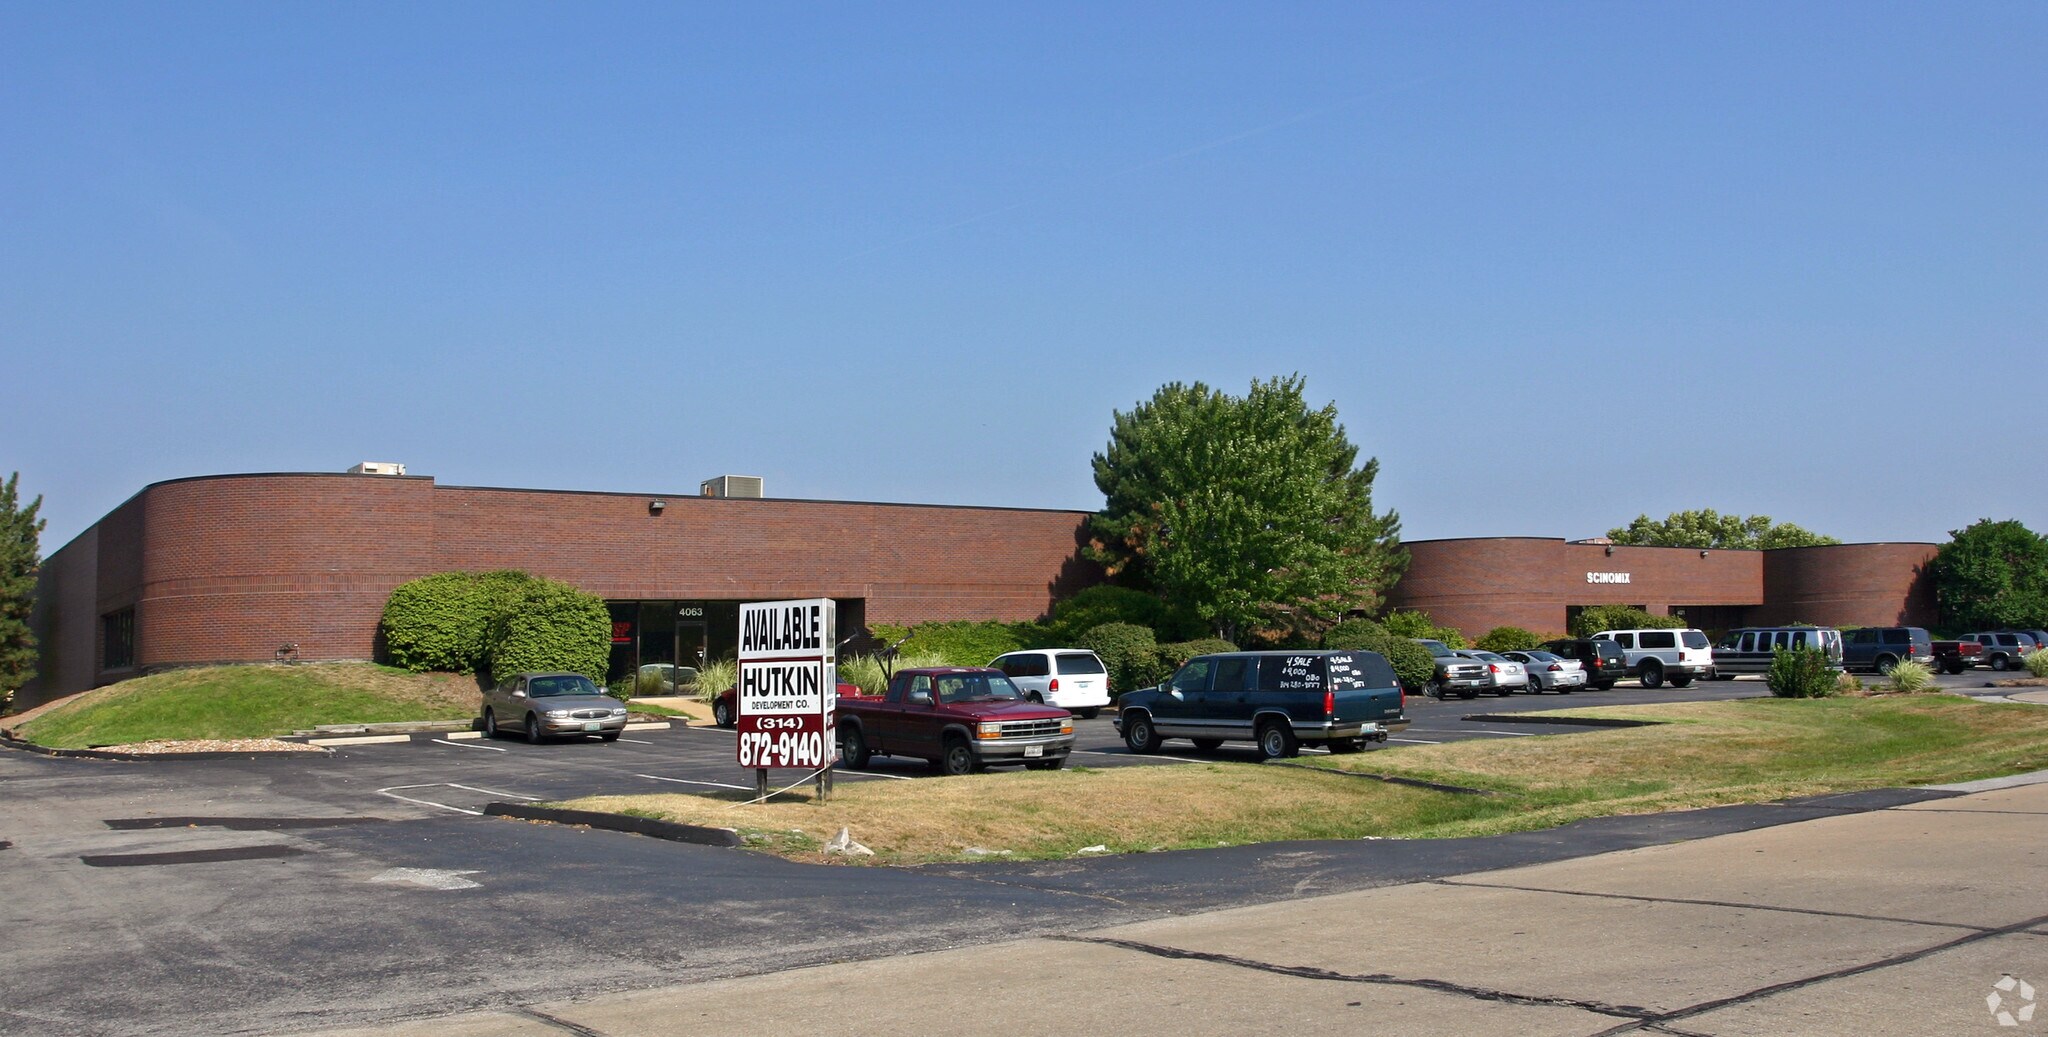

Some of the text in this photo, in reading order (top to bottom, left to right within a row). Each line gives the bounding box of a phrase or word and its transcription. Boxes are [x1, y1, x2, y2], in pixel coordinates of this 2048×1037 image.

[1586, 571, 1631, 584] SCINOMIX
[679, 607, 703, 617] 4063
[742, 605, 820, 652] AVAILABLE
[1286, 656, 1313, 667] 4 SALE
[743, 665, 819, 697] HUTKIN
[751, 699, 810, 710] DEVELOPMENT CO.
[756, 716, 804, 730] (314)
[740, 731, 822, 767] 872-9140
